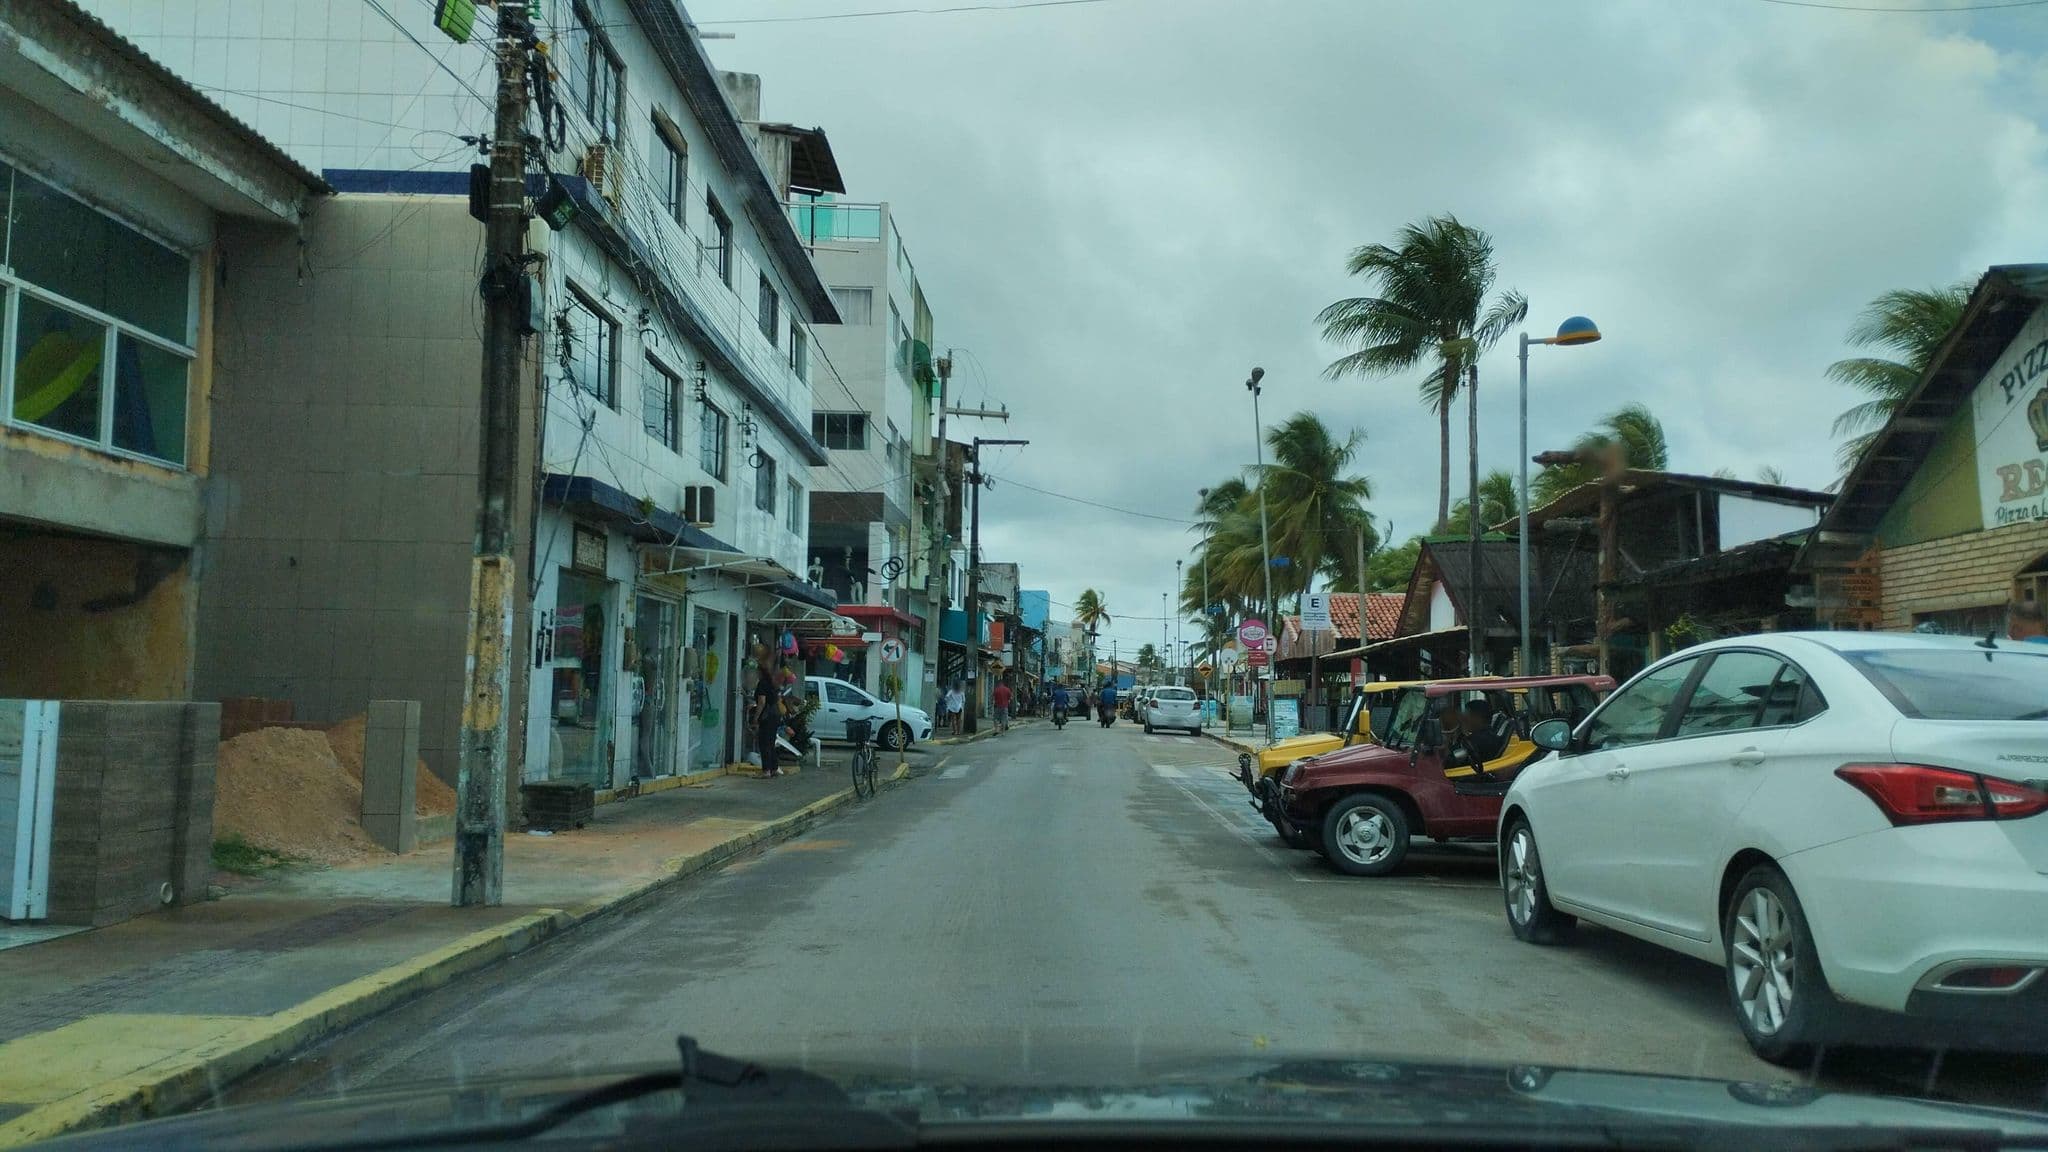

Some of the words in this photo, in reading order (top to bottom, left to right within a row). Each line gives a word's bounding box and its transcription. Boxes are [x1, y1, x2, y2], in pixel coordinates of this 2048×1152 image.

[1997, 458, 2048, 503] RE
[1994, 505, 2030, 524] Pizza
[1311, 598, 1319, 608] E
